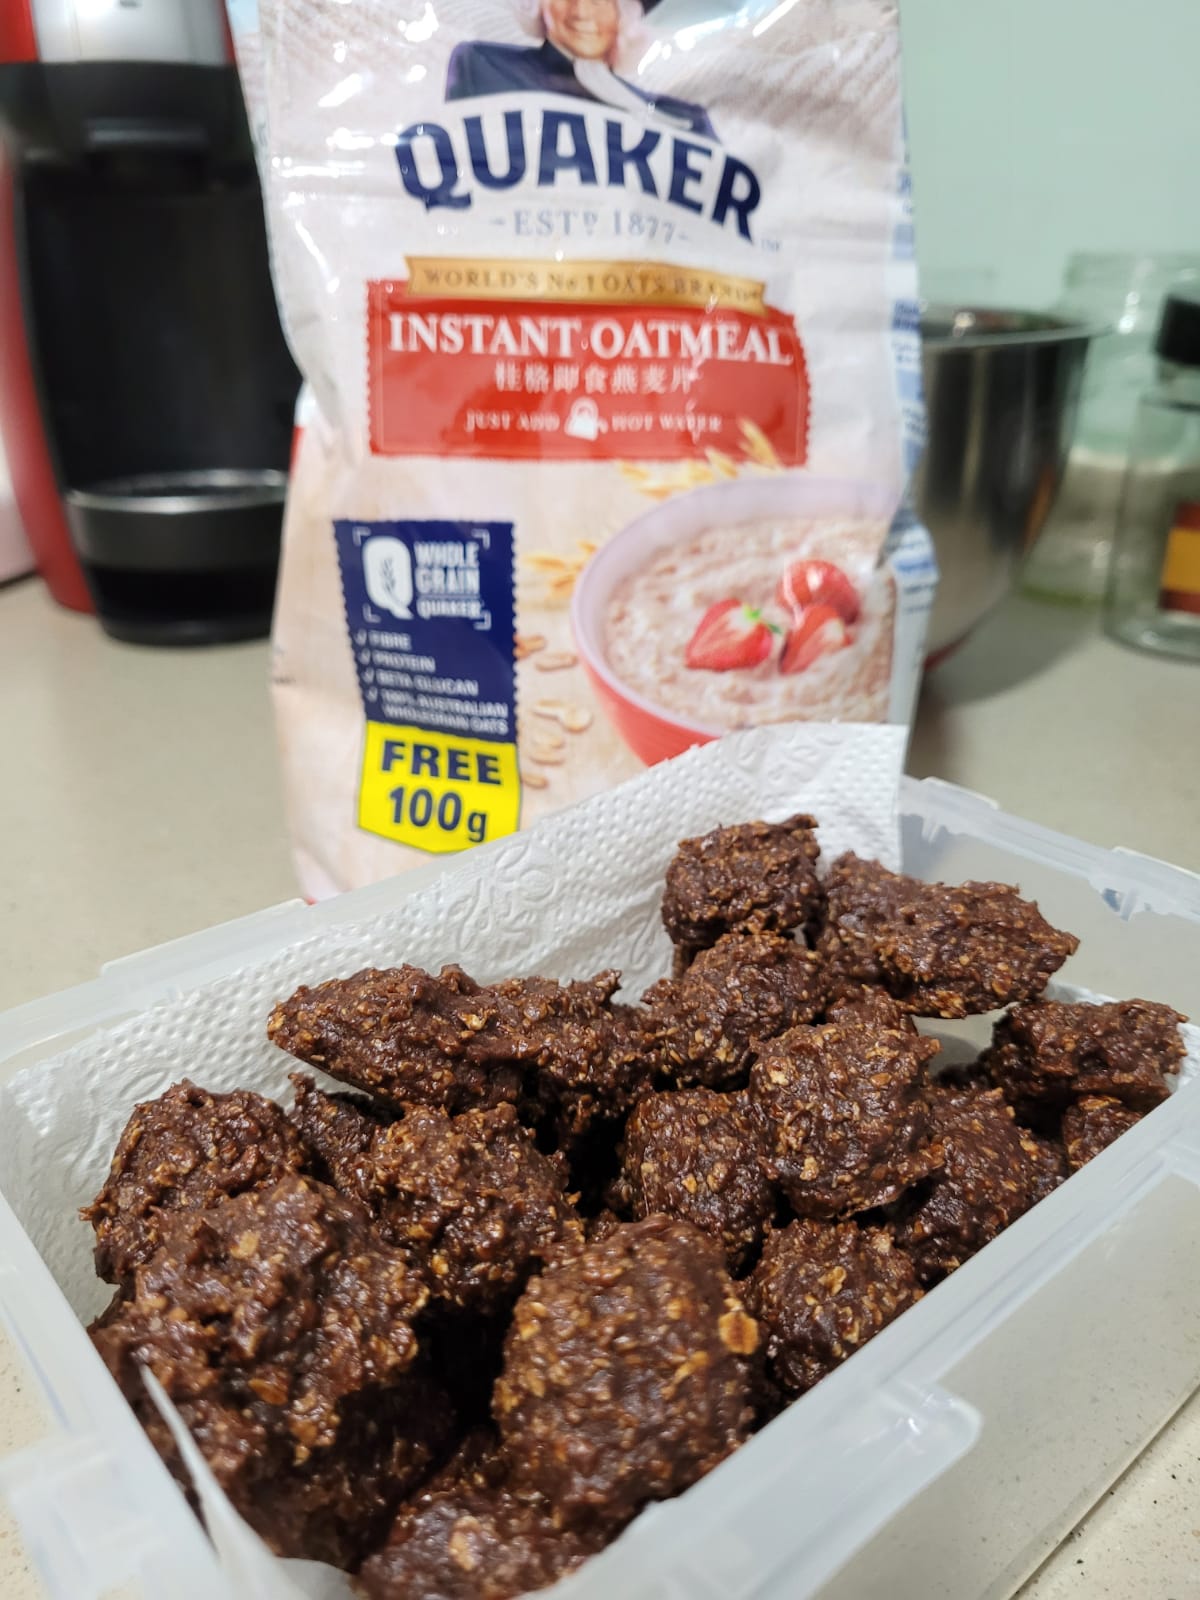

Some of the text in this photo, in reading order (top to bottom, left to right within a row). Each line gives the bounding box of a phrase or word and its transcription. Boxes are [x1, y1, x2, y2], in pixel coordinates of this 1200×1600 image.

[394, 108, 763, 242] QUAKER
[424, 268, 540, 289] WORLD'S
[602, 273, 666, 296] OATS
[387, 312, 794, 366] INSTANT OATMEAL
[465, 408, 723, 433] JUST ADD HOT WATER
[413, 541, 480, 568] WHOLE
[414, 567, 480, 595] GRAIN
[416, 598, 482, 620] QUAKER
[368, 629, 412, 651] FIBRE
[372, 650, 436, 673] PROTEIN
[376, 668, 479, 697] BETA GLUCAN
[416, 693, 509, 719] AUSTRALIAN
[470, 716, 509, 736] OATS
[381, 740, 502, 786] FREE
[389, 786, 488, 843] 100g
